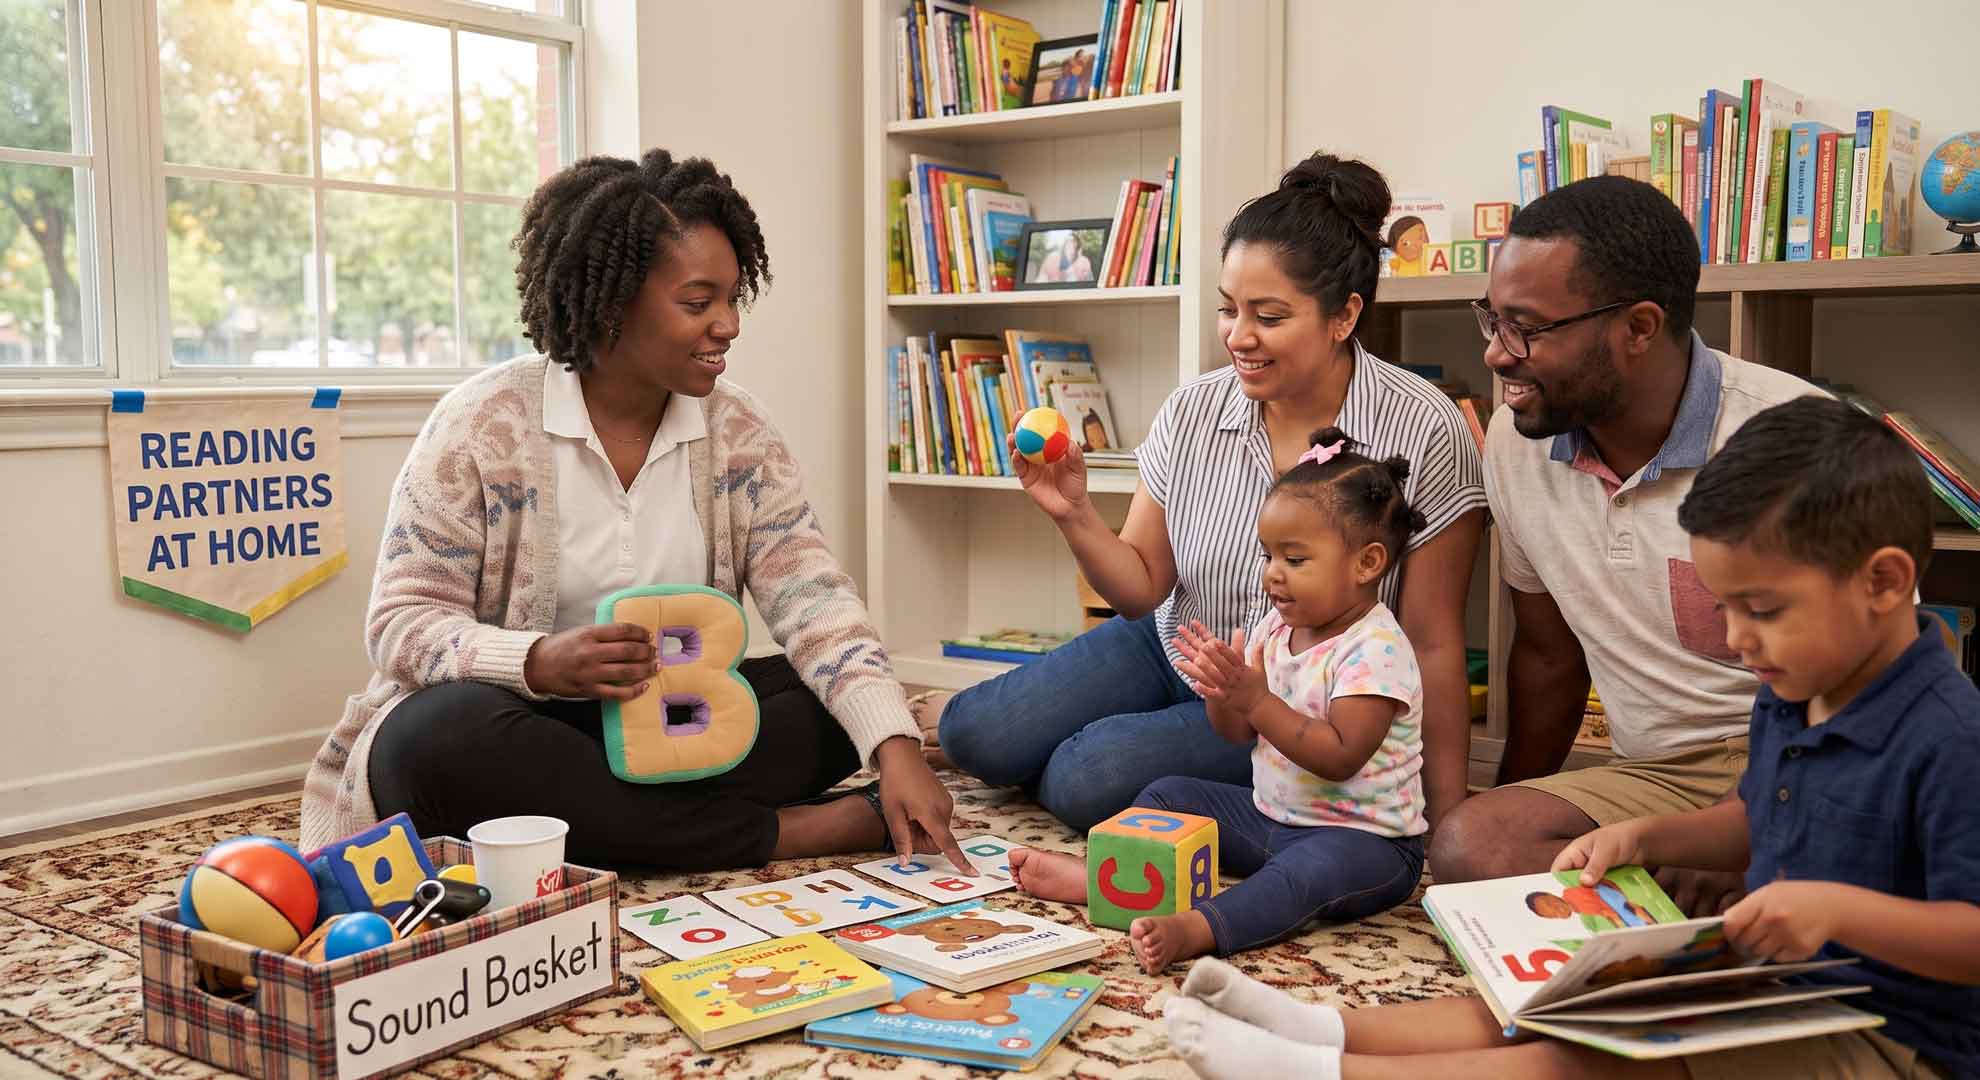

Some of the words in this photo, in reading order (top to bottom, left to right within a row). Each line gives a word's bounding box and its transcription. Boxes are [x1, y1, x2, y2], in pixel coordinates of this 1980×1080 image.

[1429, 249, 1449, 272] A
[1460, 247, 1477, 269] B
[141, 427, 316, 469] READING
[128, 473, 333, 522] PARTNERS
[147, 532, 196, 572] AT
[209, 522, 321, 565] HOME
[595, 584, 760, 784] B
[346, 967, 469, 1055] Sound
[486, 921, 602, 1009] Basket
